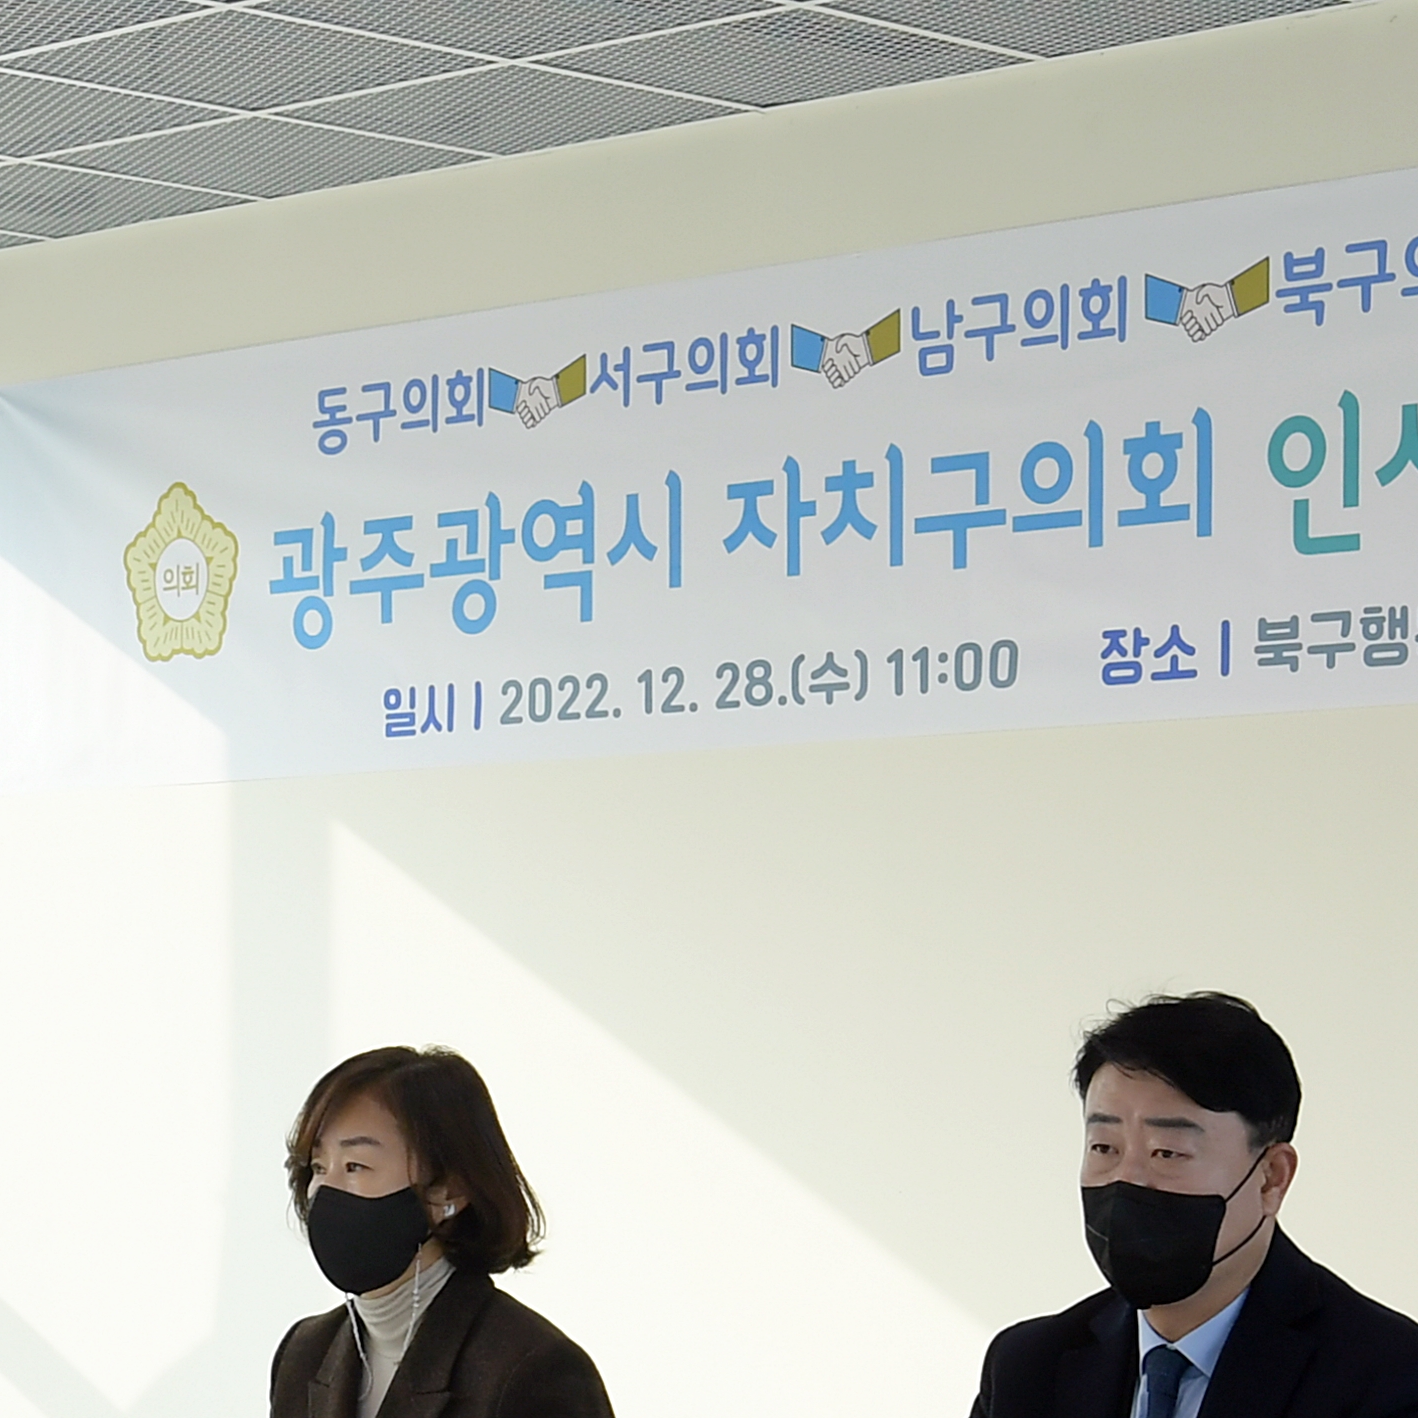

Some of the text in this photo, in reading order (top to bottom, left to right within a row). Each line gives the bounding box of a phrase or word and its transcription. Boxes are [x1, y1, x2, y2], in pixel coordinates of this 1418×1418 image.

[312, 367, 484, 455] 동구의회
[588, 325, 780, 408] 서구의회
[910, 275, 1128, 377] 남구의회
[268, 469, 683, 650] 광주광역시
[722, 406, 1214, 577] 자치구의회
[163, 562, 200, 598] 의회
[382, 682, 456, 739] 일시
[498, 671, 622, 726] 2022.
[635, 665, 699, 716] 12.
[885, 639, 1020, 697] 11:00
[1100, 623, 1199, 687] 장소
